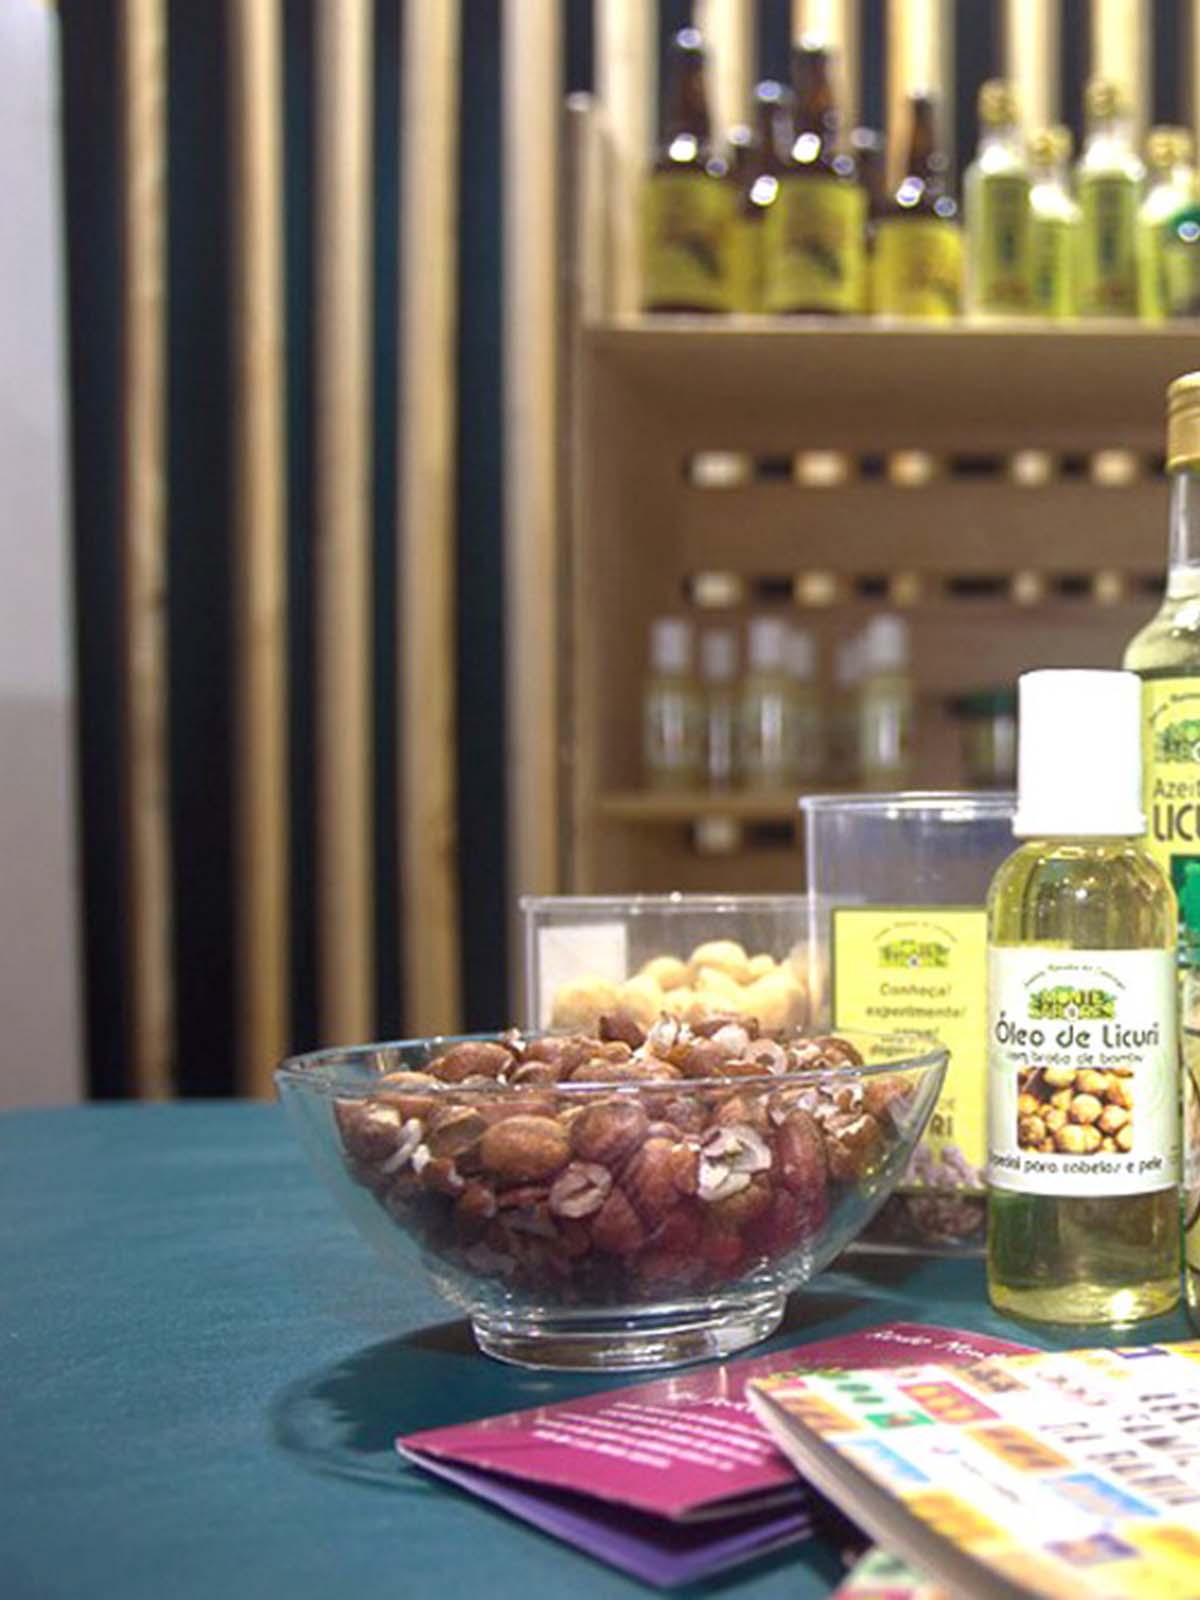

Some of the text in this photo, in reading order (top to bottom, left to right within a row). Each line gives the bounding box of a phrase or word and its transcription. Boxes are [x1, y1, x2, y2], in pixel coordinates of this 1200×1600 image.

[994, 1010, 1160, 1049] Óleo de Licuri
